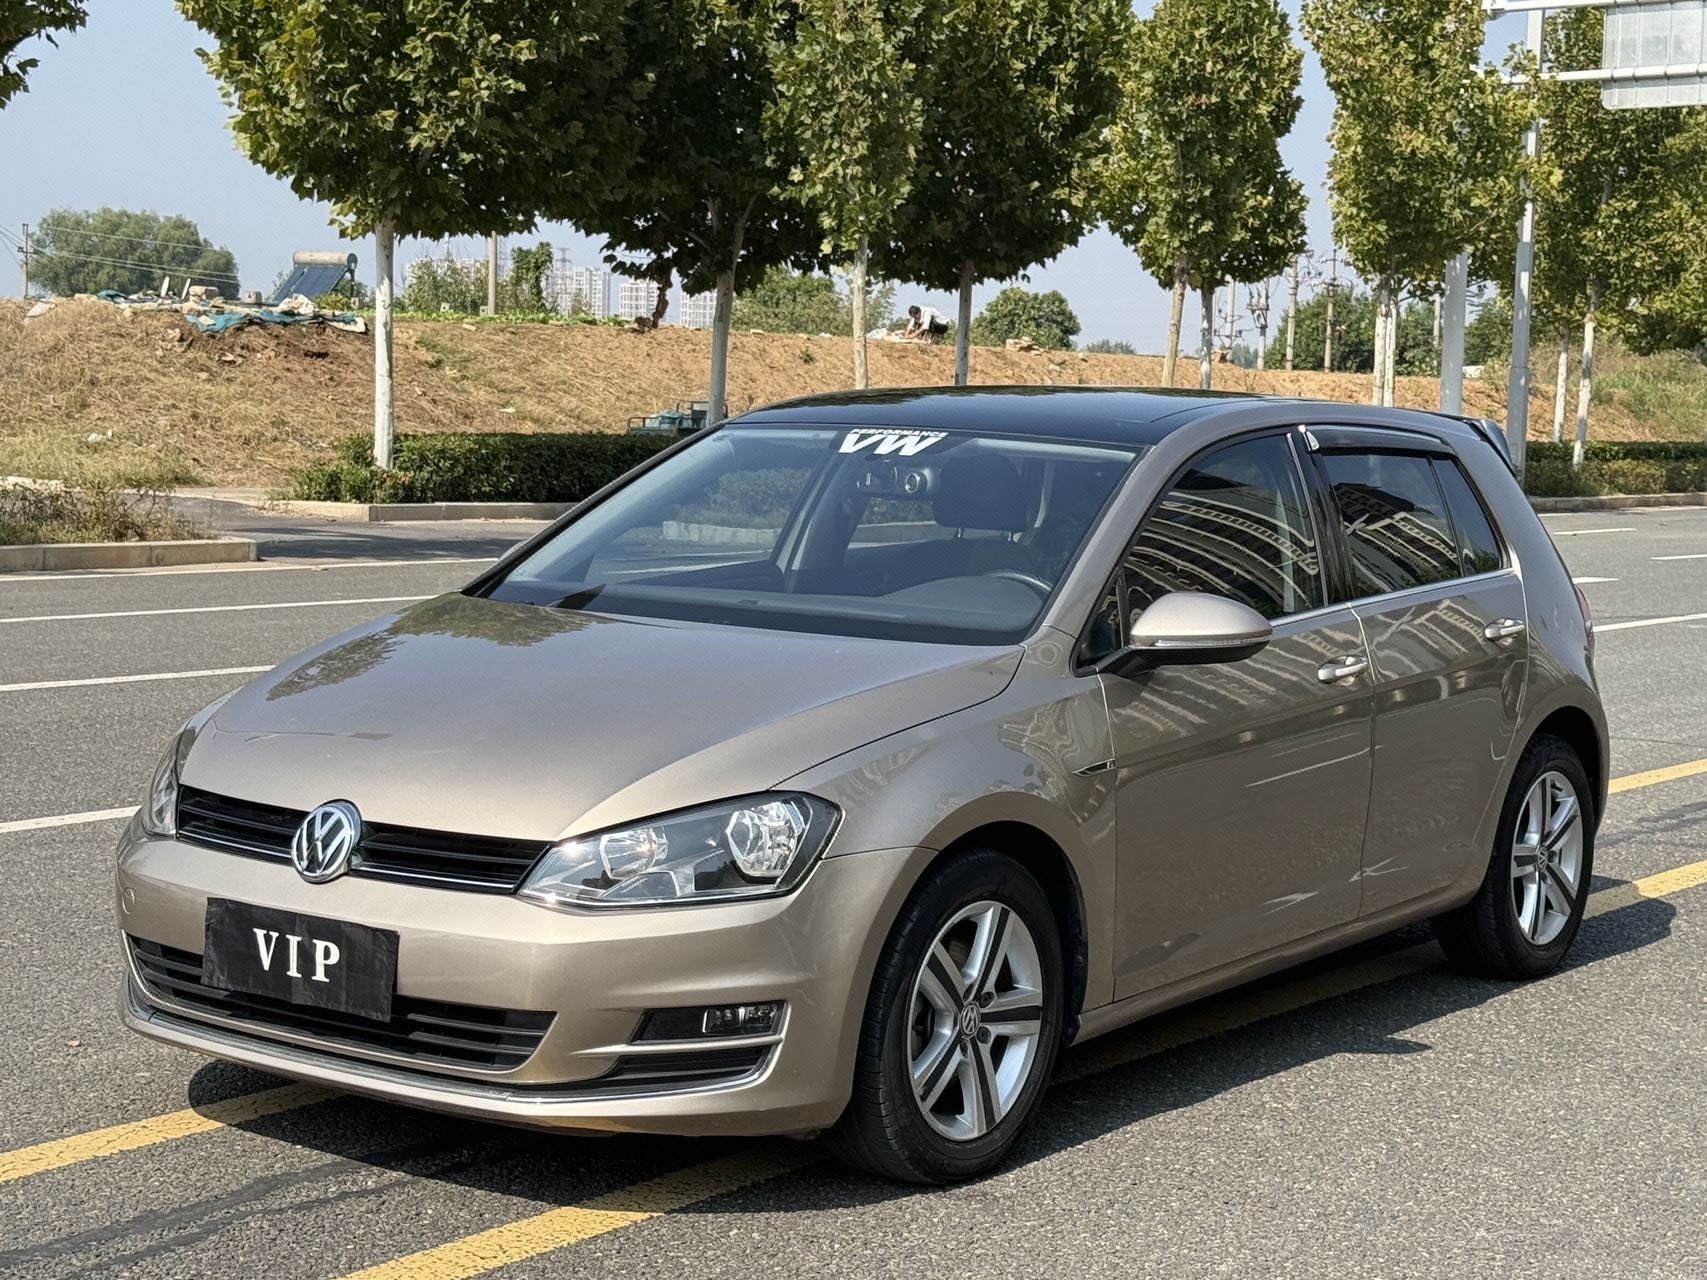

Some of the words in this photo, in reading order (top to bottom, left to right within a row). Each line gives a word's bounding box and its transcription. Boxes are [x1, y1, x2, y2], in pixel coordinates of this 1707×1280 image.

[838, 433, 943, 456] VW
[293, 803, 355, 878] VW
[253, 928, 340, 982] VIP
